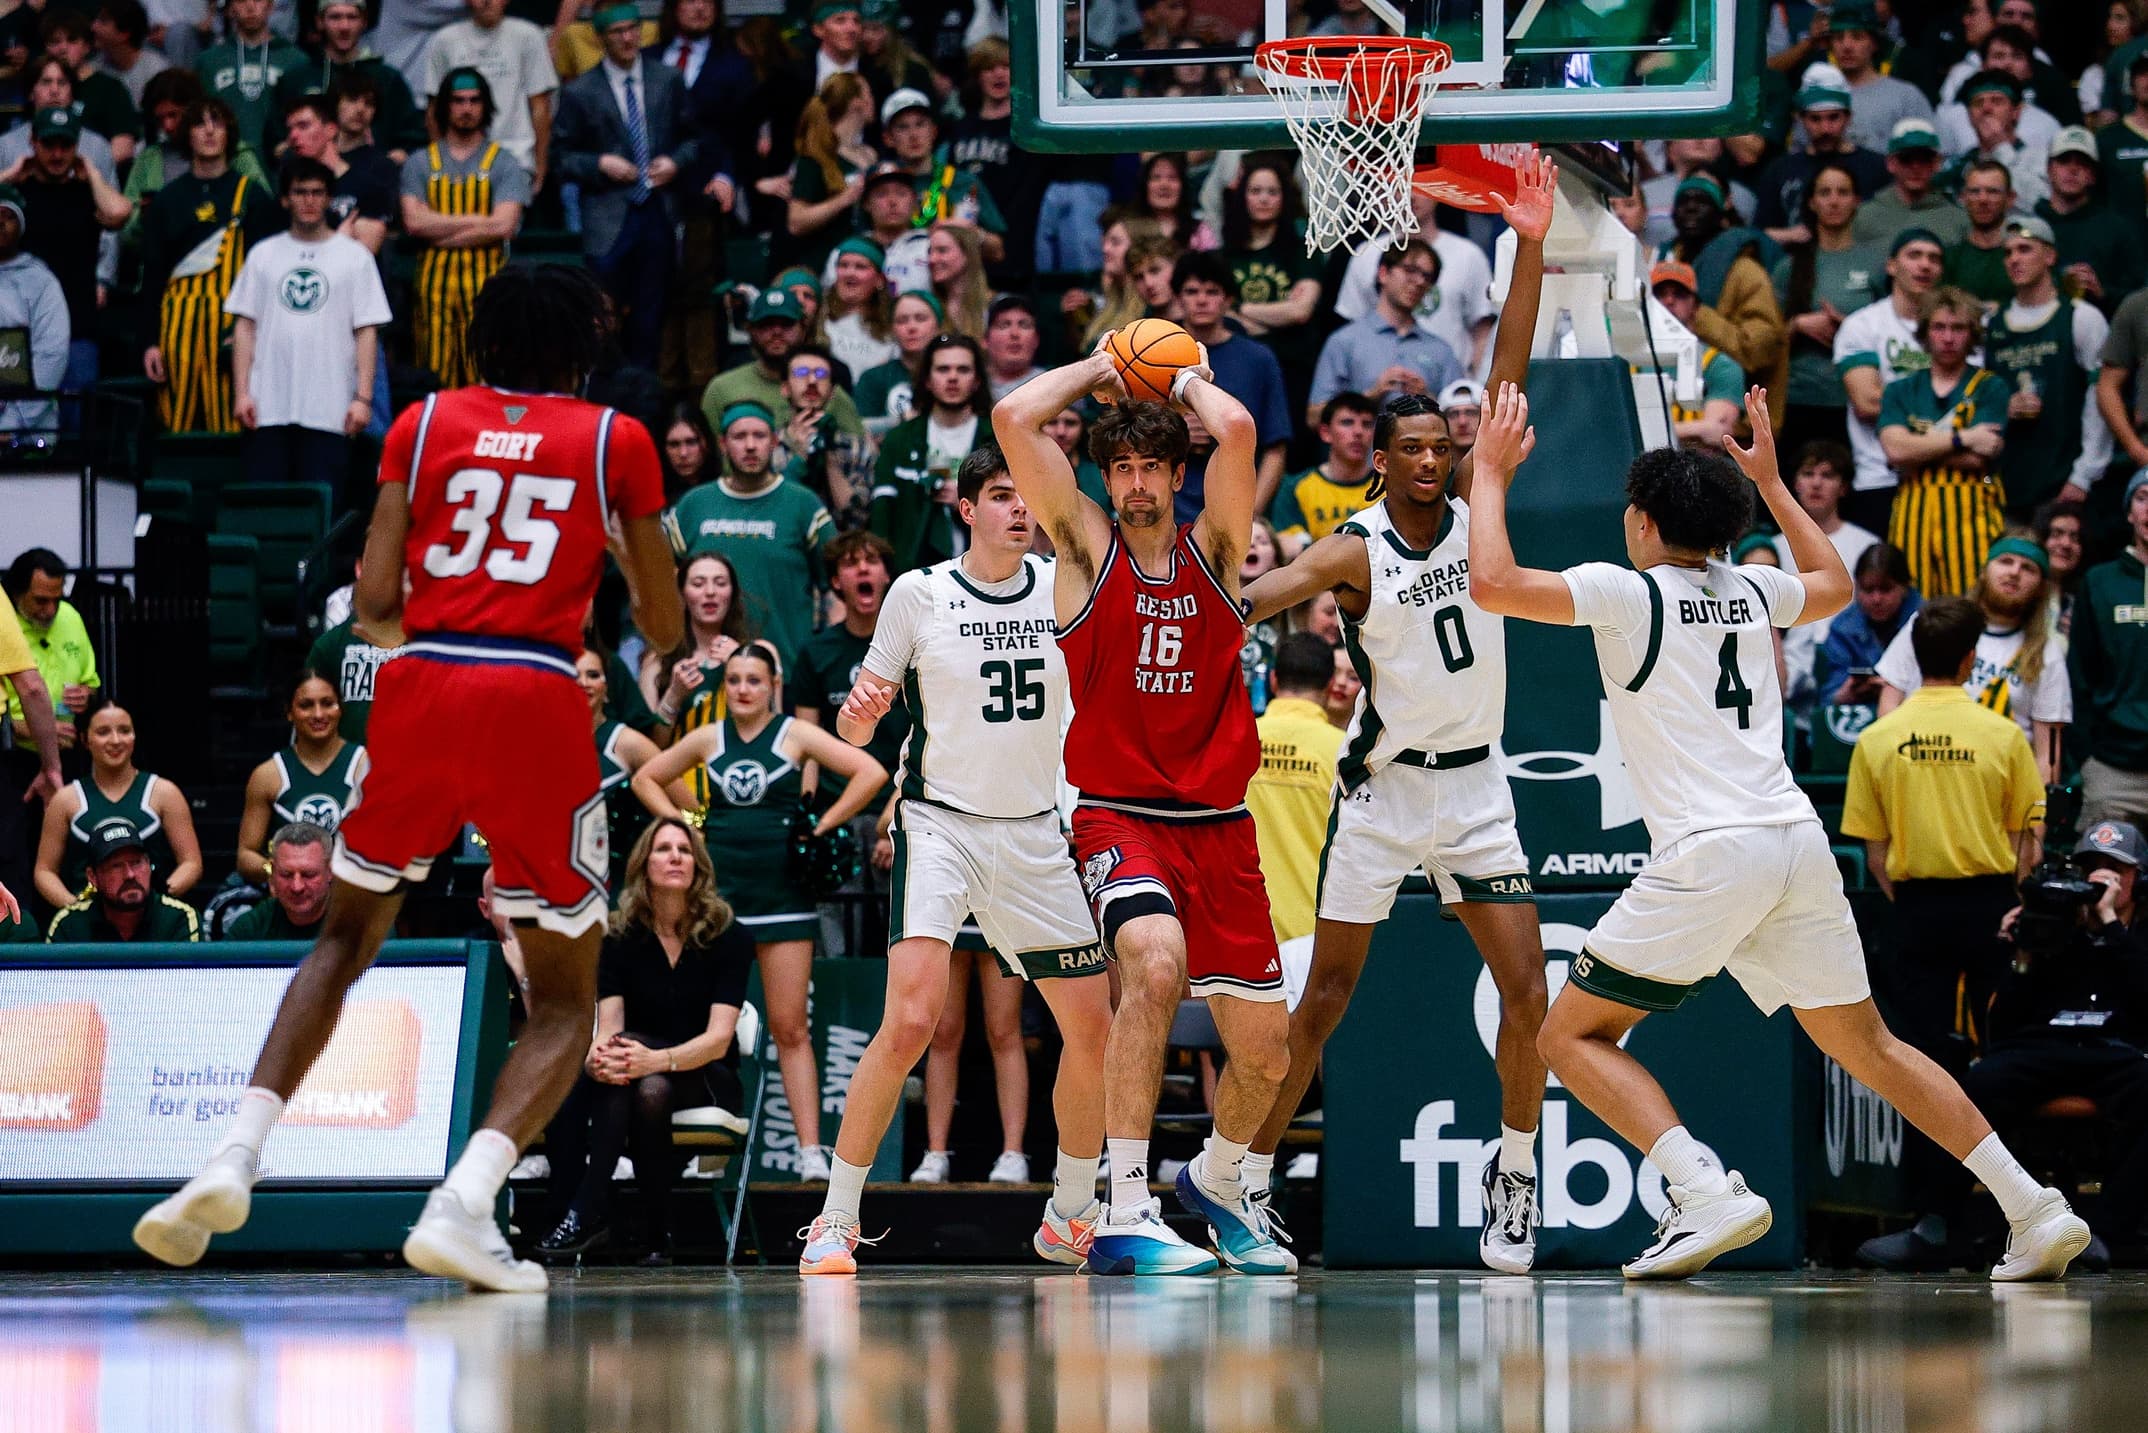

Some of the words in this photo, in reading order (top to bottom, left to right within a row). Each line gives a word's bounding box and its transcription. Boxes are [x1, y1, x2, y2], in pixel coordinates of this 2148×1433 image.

[473, 430, 543, 461] GORY
[424, 468, 577, 585] 35
[1397, 559, 1469, 605] CLORAD
[1412, 576, 1467, 607] STATE
[1134, 593, 1198, 620] RESNO
[1679, 598, 1753, 625] BUTLER
[959, 619, 1056, 637] COLORADO
[1433, 604, 1475, 674] 0
[983, 635, 1040, 651] STATE
[1138, 622, 1183, 667] 16
[980, 658, 1045, 723] 35
[1715, 631, 1753, 730] 4
[1260, 743, 1297, 756] LLIED
[1262, 758, 1319, 774] NIVERSAL
[1539, 852, 1652, 876] ARMO
[1490, 877, 1534, 894] RAM
[1058, 945, 1105, 970] RAM
[149, 1093, 188, 1115] for
[195, 1099, 240, 1121] goo
